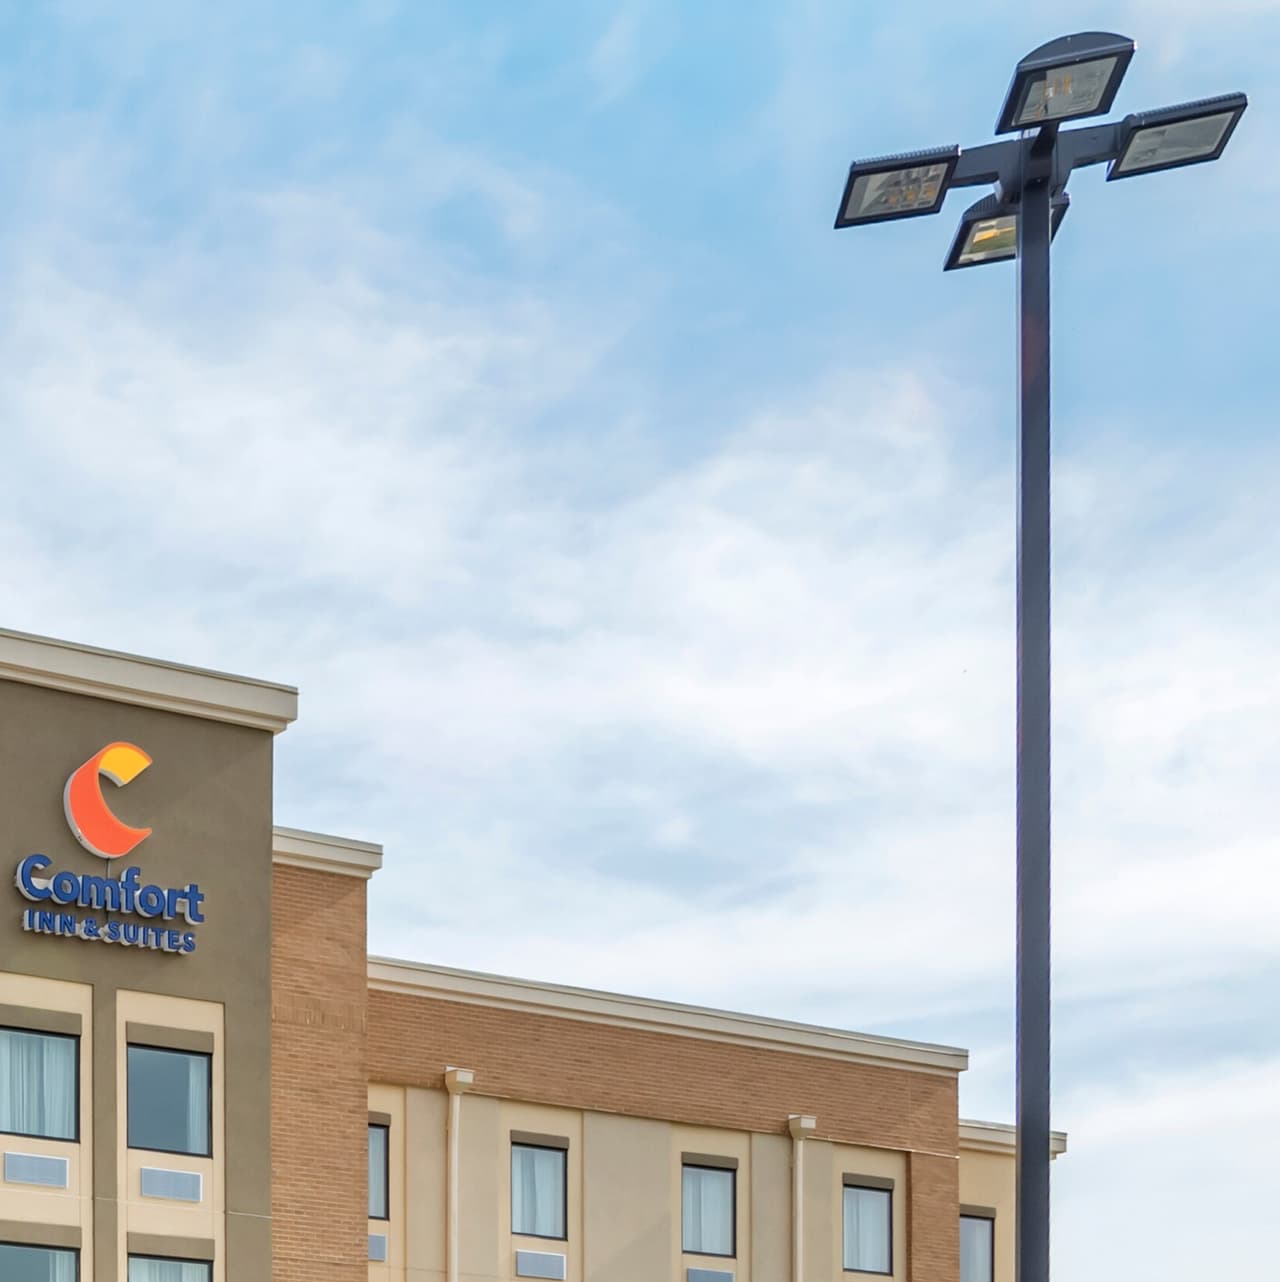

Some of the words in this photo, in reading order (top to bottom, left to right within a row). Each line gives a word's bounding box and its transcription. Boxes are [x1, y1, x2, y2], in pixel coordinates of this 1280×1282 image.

[17, 854, 205, 924] Comfort
[24, 908, 76, 936] INN
[82, 917, 101, 940] &
[104, 920, 196, 954] SUITES
